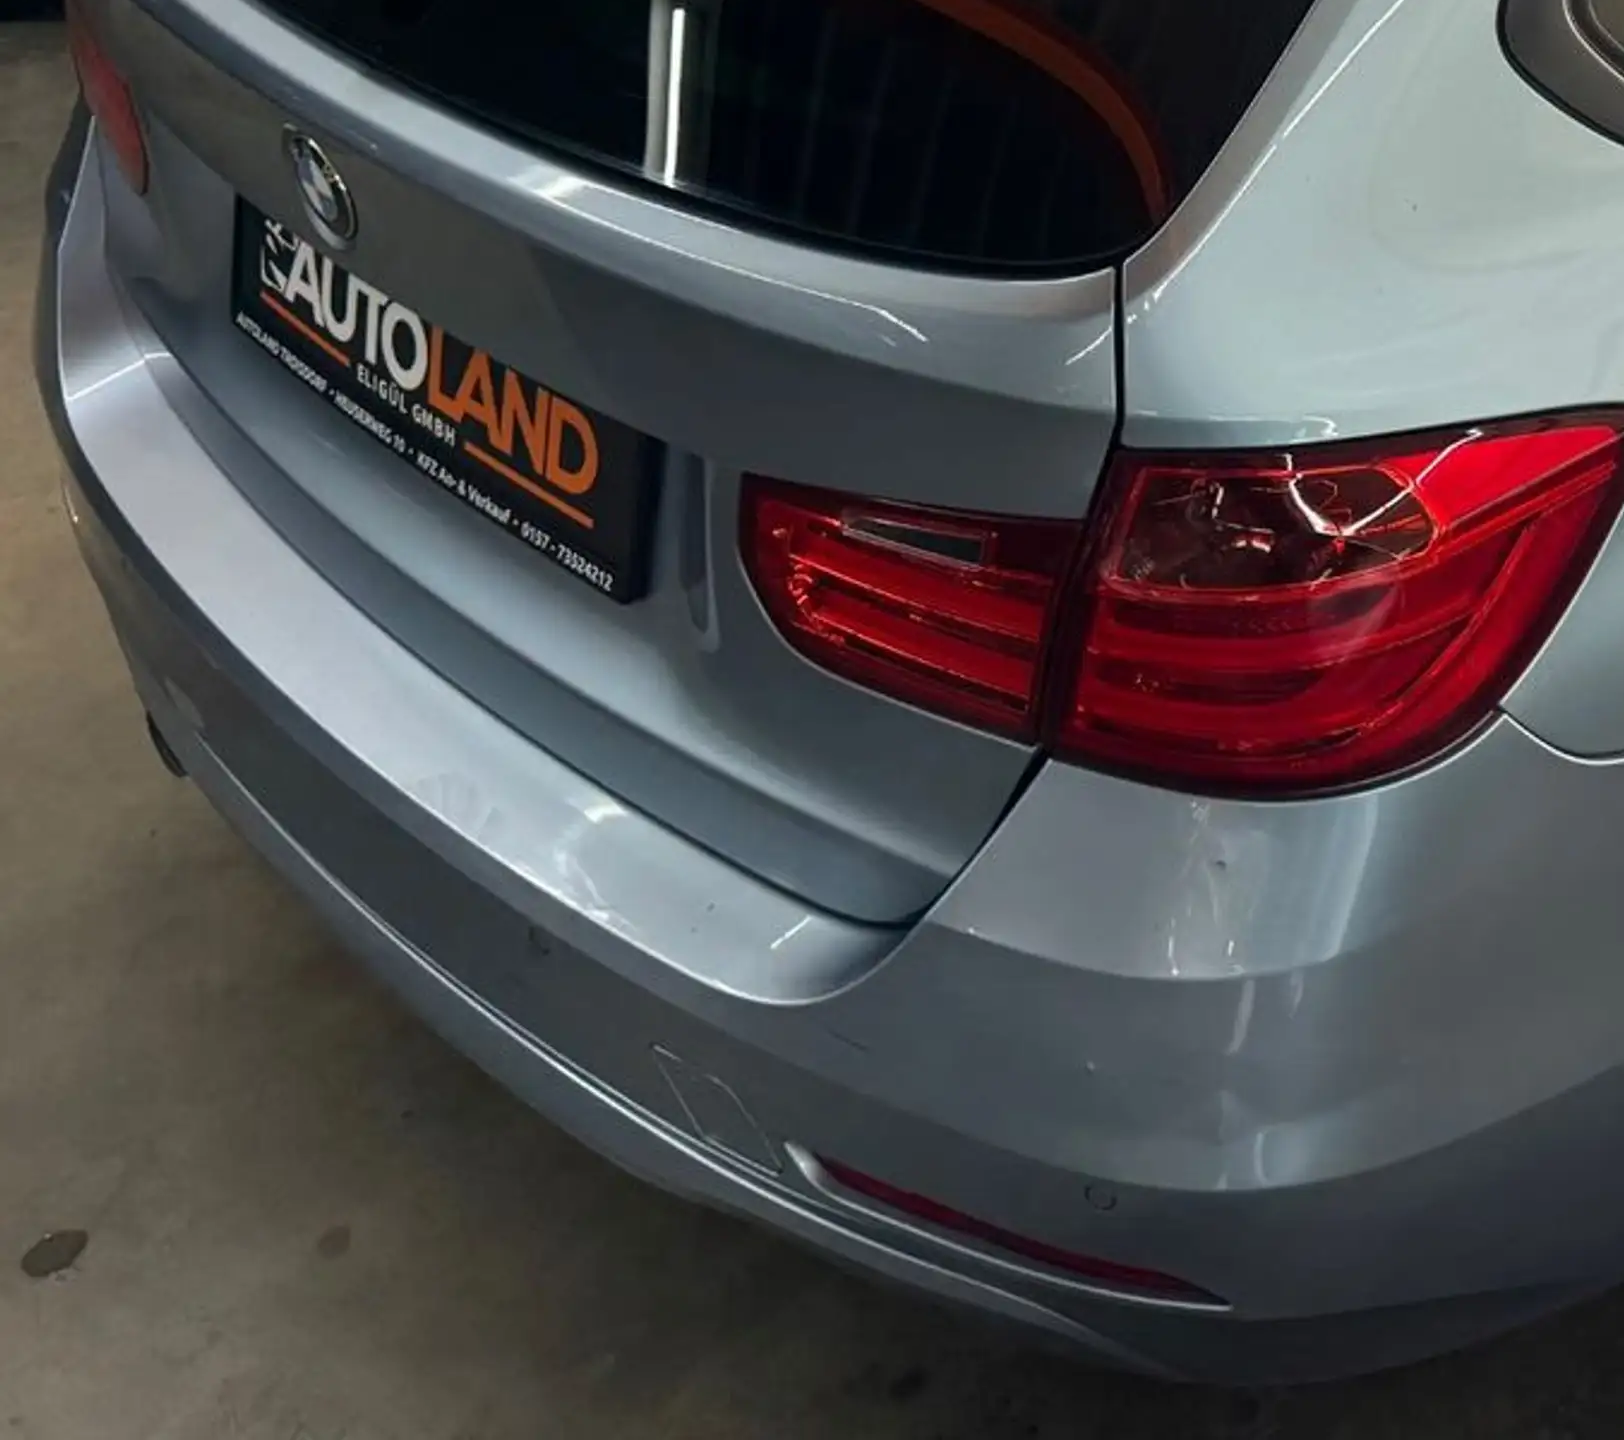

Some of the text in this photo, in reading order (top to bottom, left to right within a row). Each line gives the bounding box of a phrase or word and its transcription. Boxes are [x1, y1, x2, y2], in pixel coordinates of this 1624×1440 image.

[284, 240, 599, 495] AUTOLAND
[356, 362, 456, 447] ELIGÜL GMBH
[417, 451, 438, 476] KFZ
[467, 484, 512, 525] Verkauf
[520, 520, 552, 551] 0157
